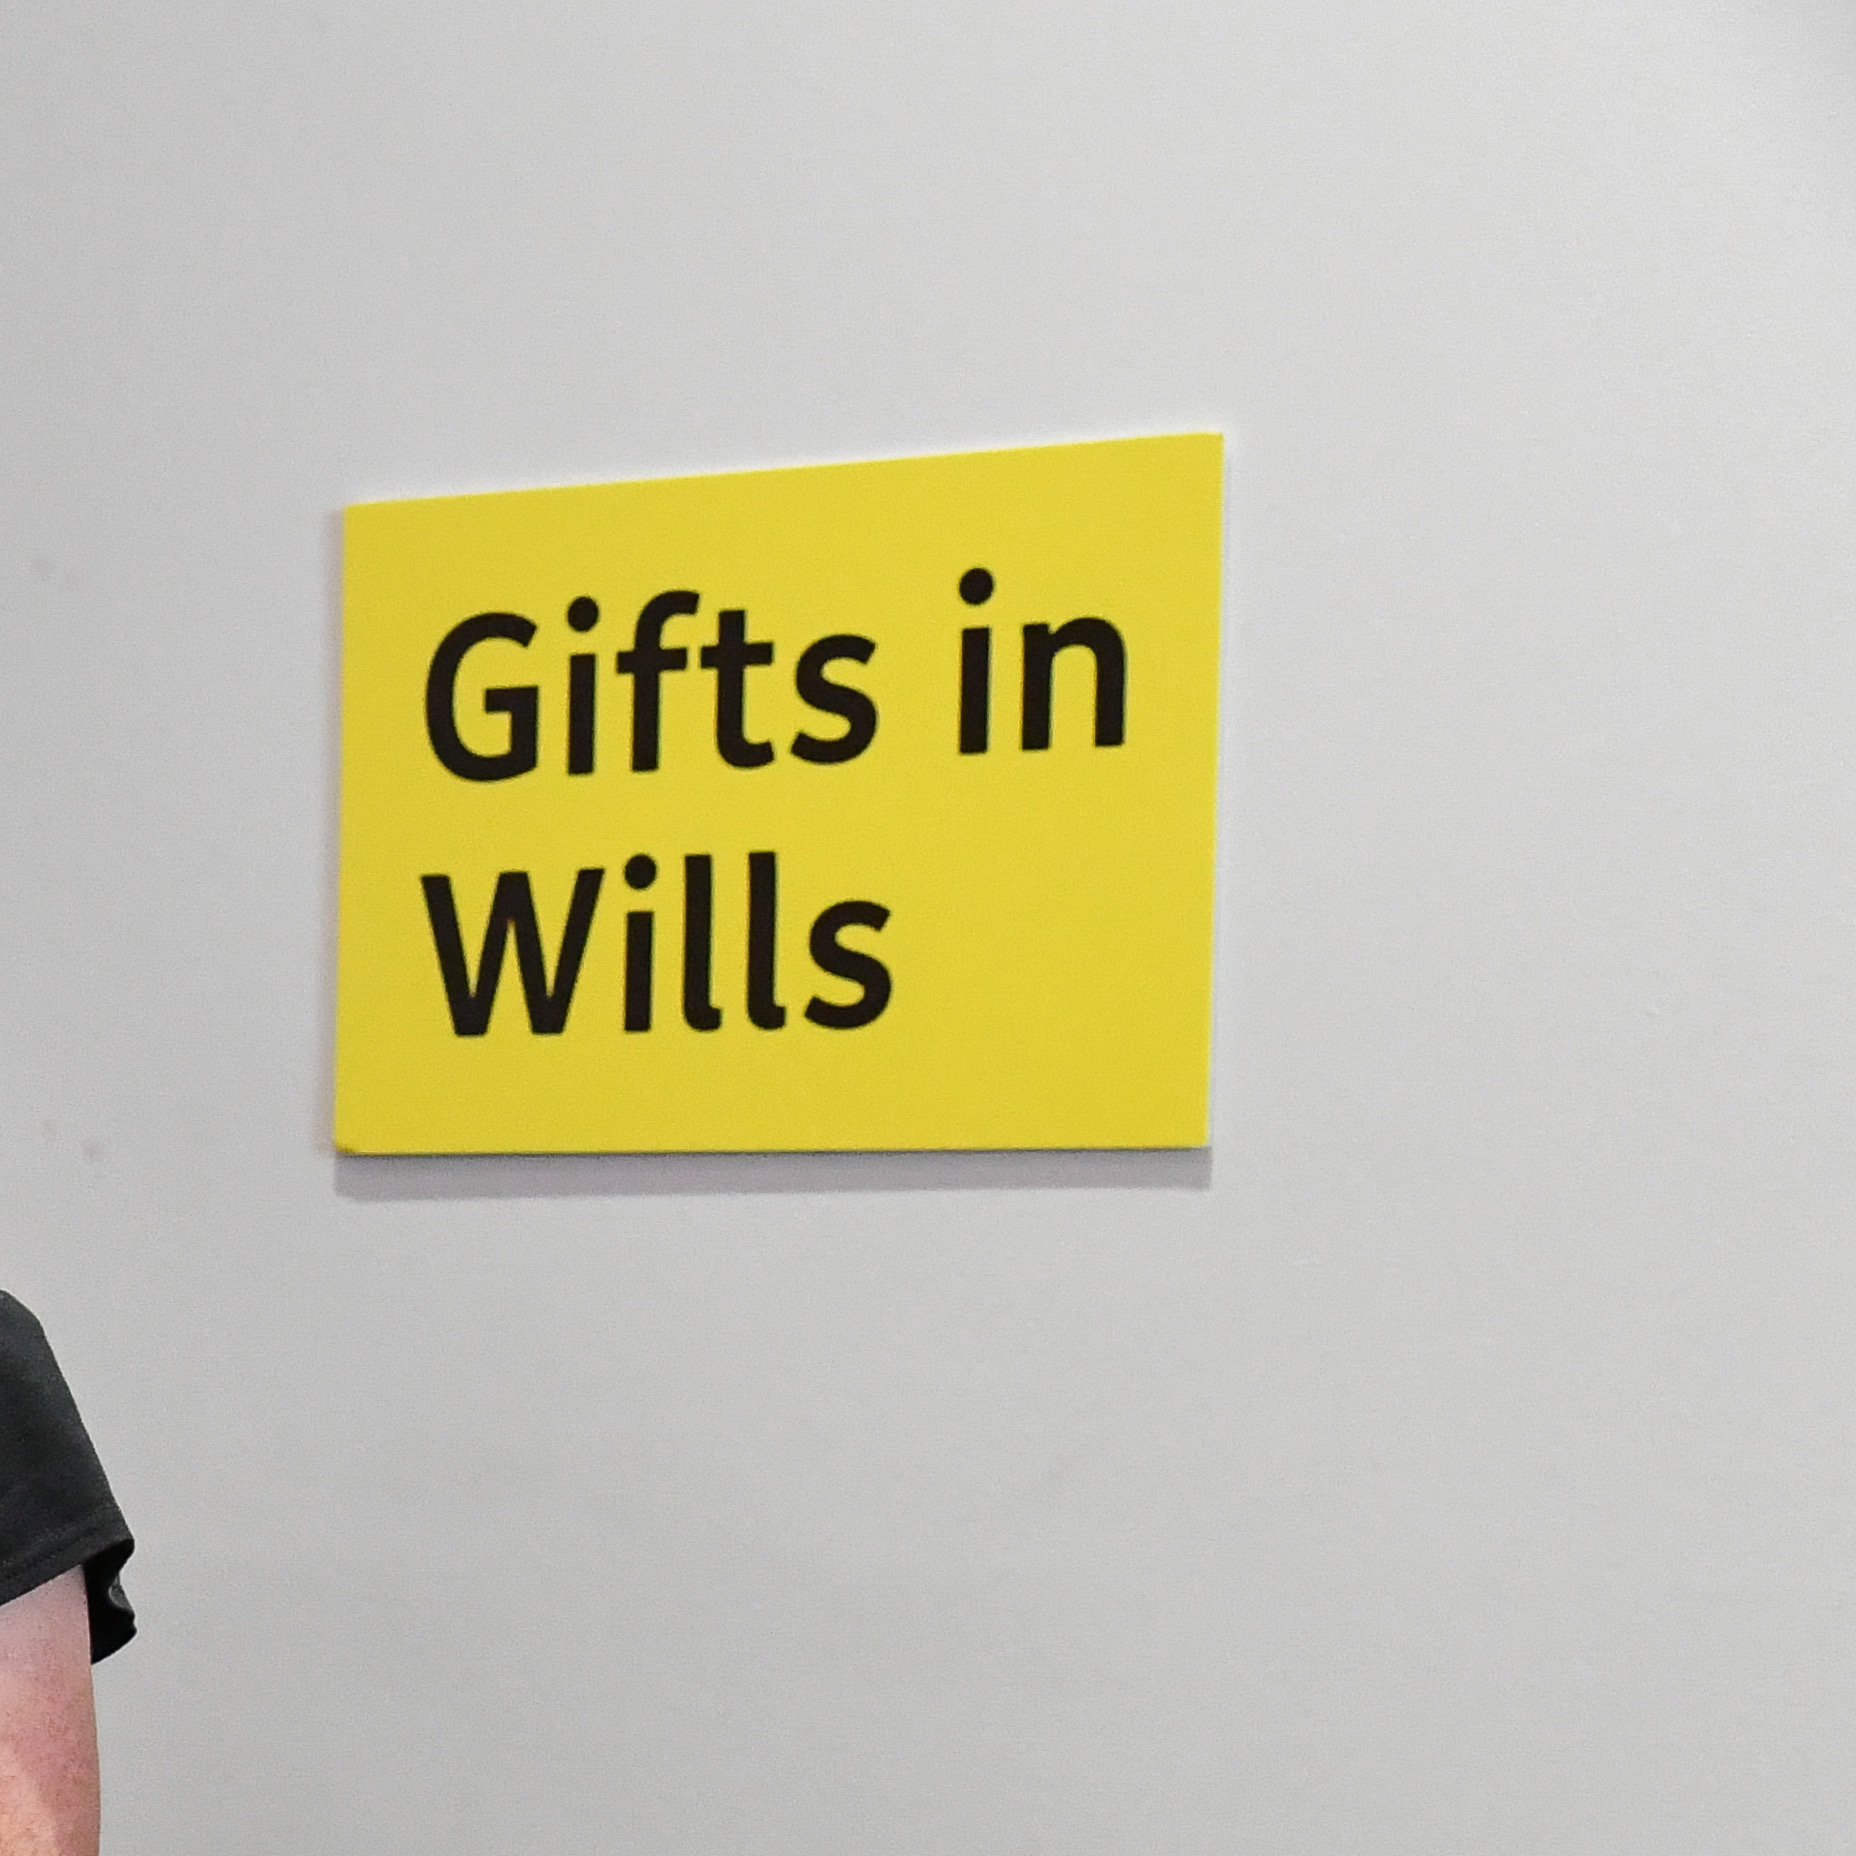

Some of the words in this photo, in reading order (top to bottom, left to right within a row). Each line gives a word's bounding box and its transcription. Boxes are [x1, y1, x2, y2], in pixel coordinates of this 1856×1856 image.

[424, 588, 878, 784] Gifts
[957, 566, 1127, 756] in
[419, 850, 893, 1039] Wills
